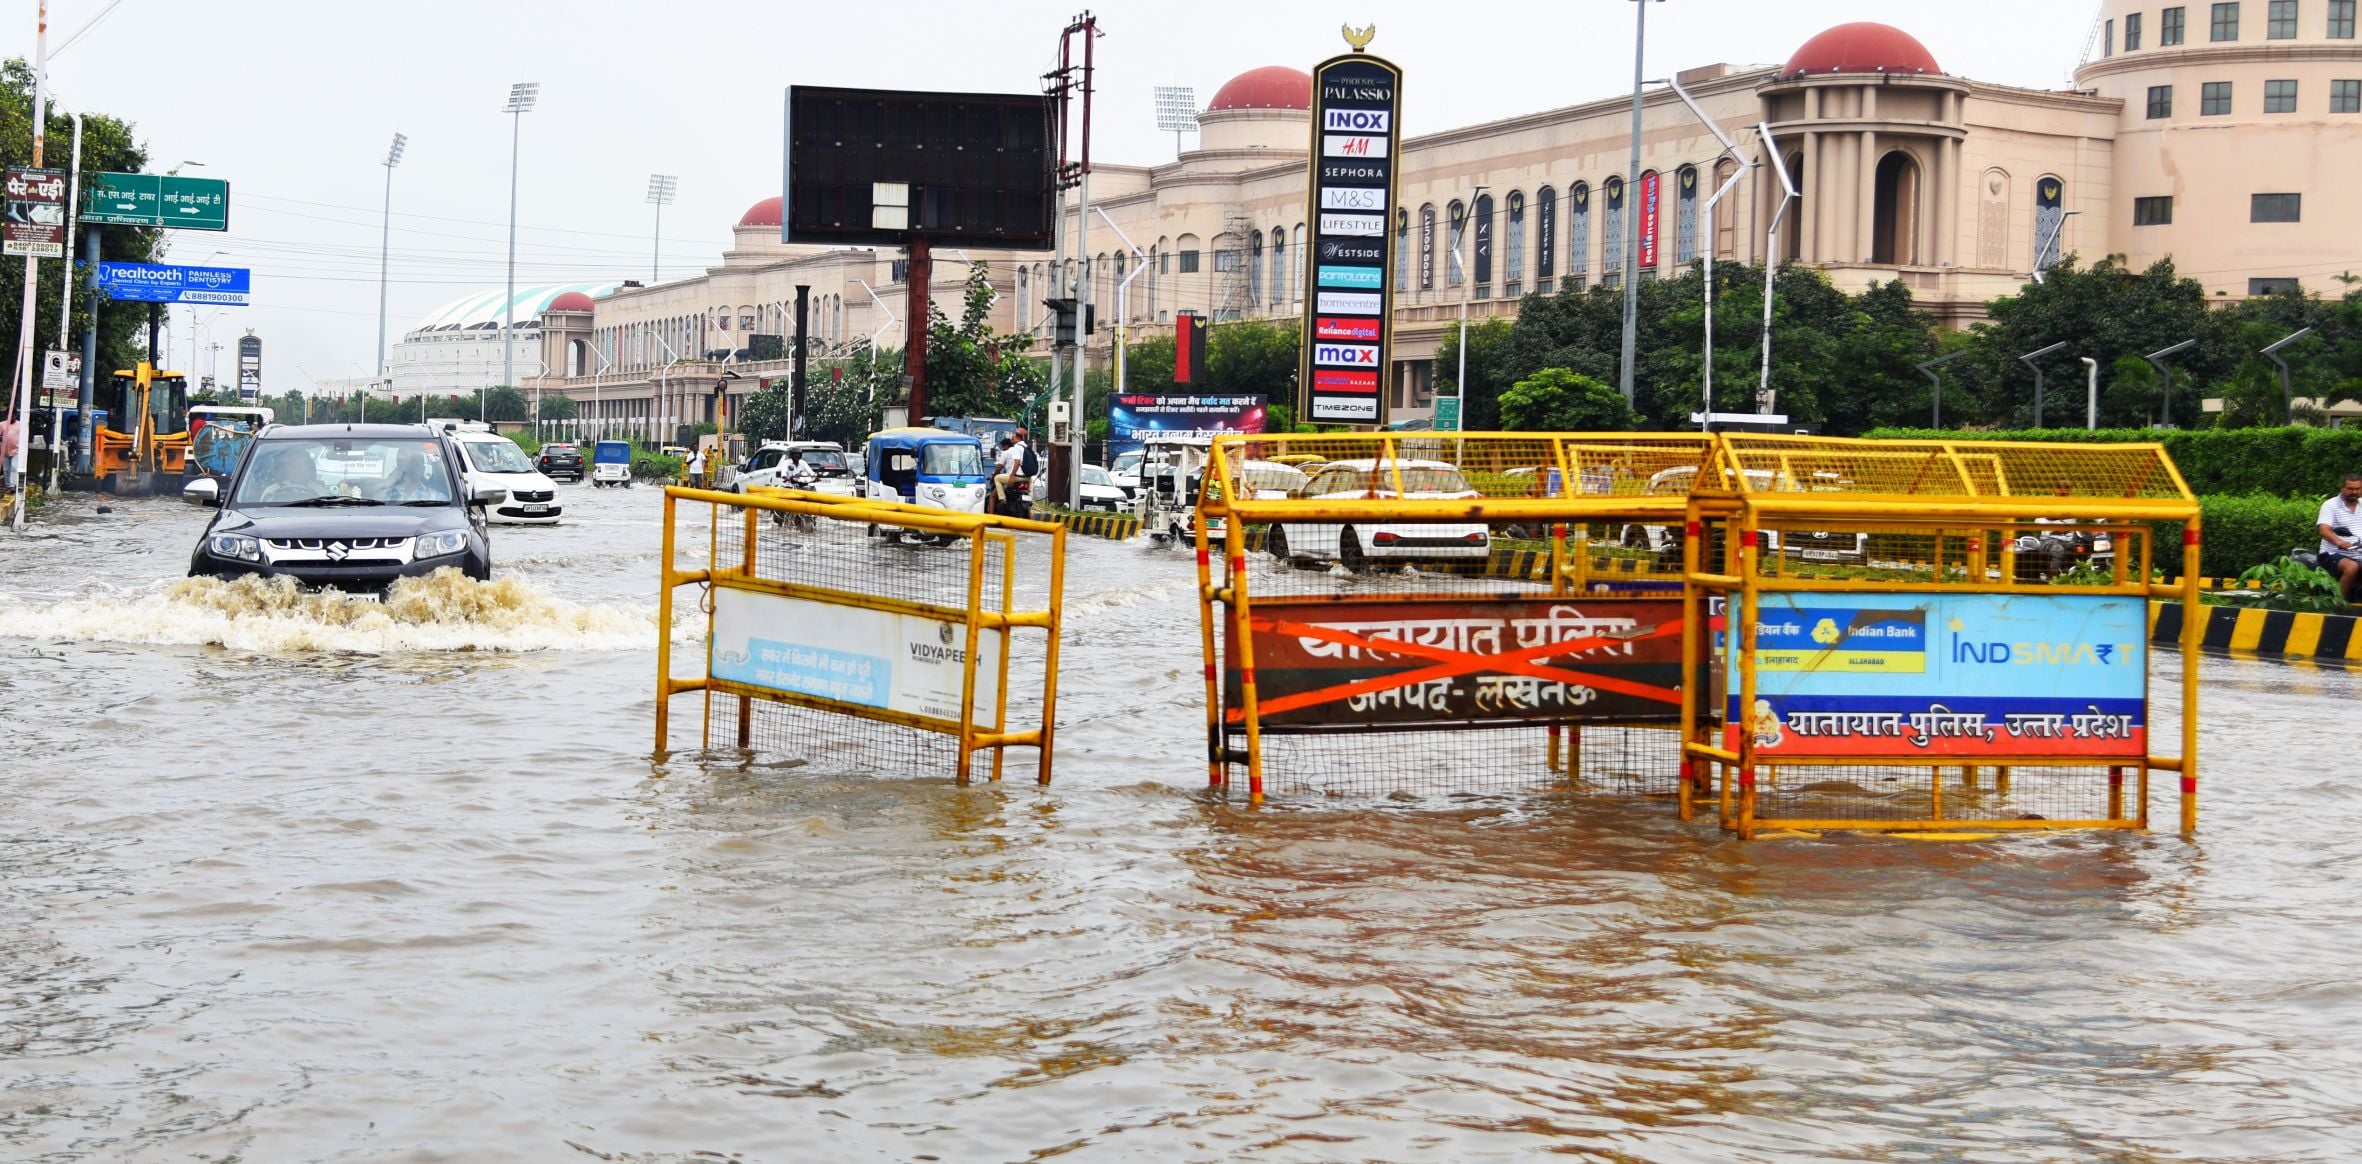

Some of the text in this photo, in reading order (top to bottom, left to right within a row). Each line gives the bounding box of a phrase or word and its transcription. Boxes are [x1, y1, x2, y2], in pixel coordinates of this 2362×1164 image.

[1325, 87, 1391, 101] PALASSIO
[1329, 112, 1383, 129] INOX
[1342, 137, 1370, 156] H&M
[1325, 167, 1383, 178] SEPHORA
[139, 192, 155, 200] टावर
[1331, 190, 1374, 208] M&S
[1323, 220, 1380, 231] LIFESTYLE
[1322, 243, 1380, 259] WESTSIDE
[112, 266, 182, 281] realtooth
[188, 276, 232, 284] DENTISTRY
[189, 270, 232, 279] PAINLESS
[191, 292, 243, 301] 8881900300
[1319, 347, 1374, 363] max
[1314, 404, 1374, 412] TIMEZONE
[1755, 621, 1781, 636] डियन
[1848, 625, 1916, 638] Indian Bank
[910, 642, 982, 667] VIDYAPEEH
[1787, 703, 2132, 747] यातायात पुलिस, उत्तर प्रदेश
